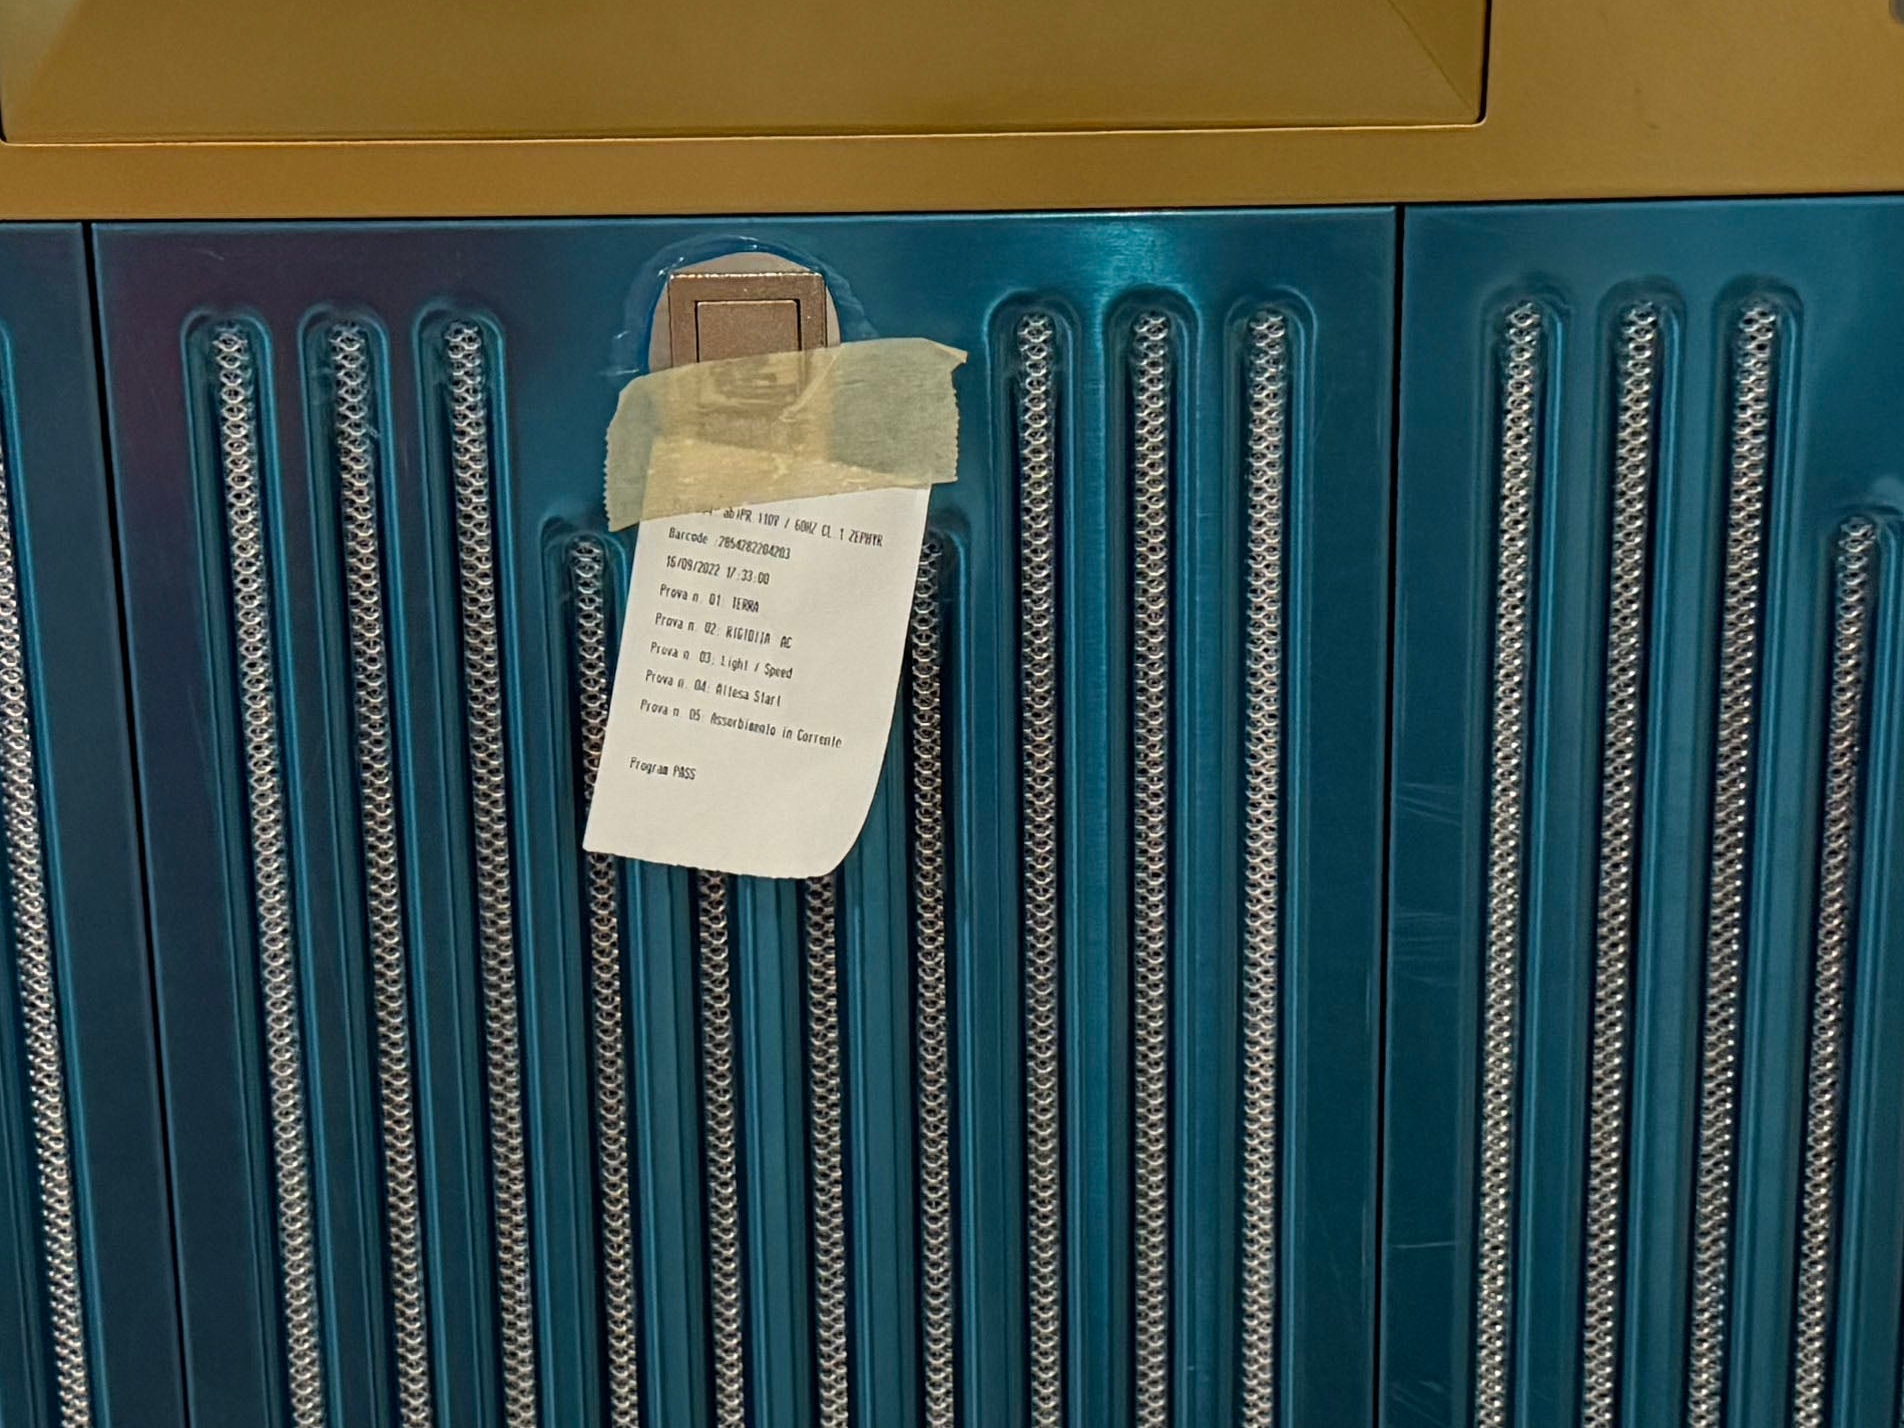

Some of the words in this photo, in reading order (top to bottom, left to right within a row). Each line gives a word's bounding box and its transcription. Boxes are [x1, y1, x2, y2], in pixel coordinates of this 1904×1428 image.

[668, 526, 709, 545] Barcode
[848, 529, 884, 548] ZEPHYR
[659, 583, 689, 601] Prova
[655, 612, 684, 630] Prova
[650, 641, 679, 659] Prova
[720, 654, 748, 672] Light
[763, 662, 794, 680] Speed
[645, 668, 674, 687] Prova
[640, 698, 669, 716] Prova
[782, 724, 793, 740] in
[629, 756, 669, 775] Program
[672, 764, 697, 780] PASS
